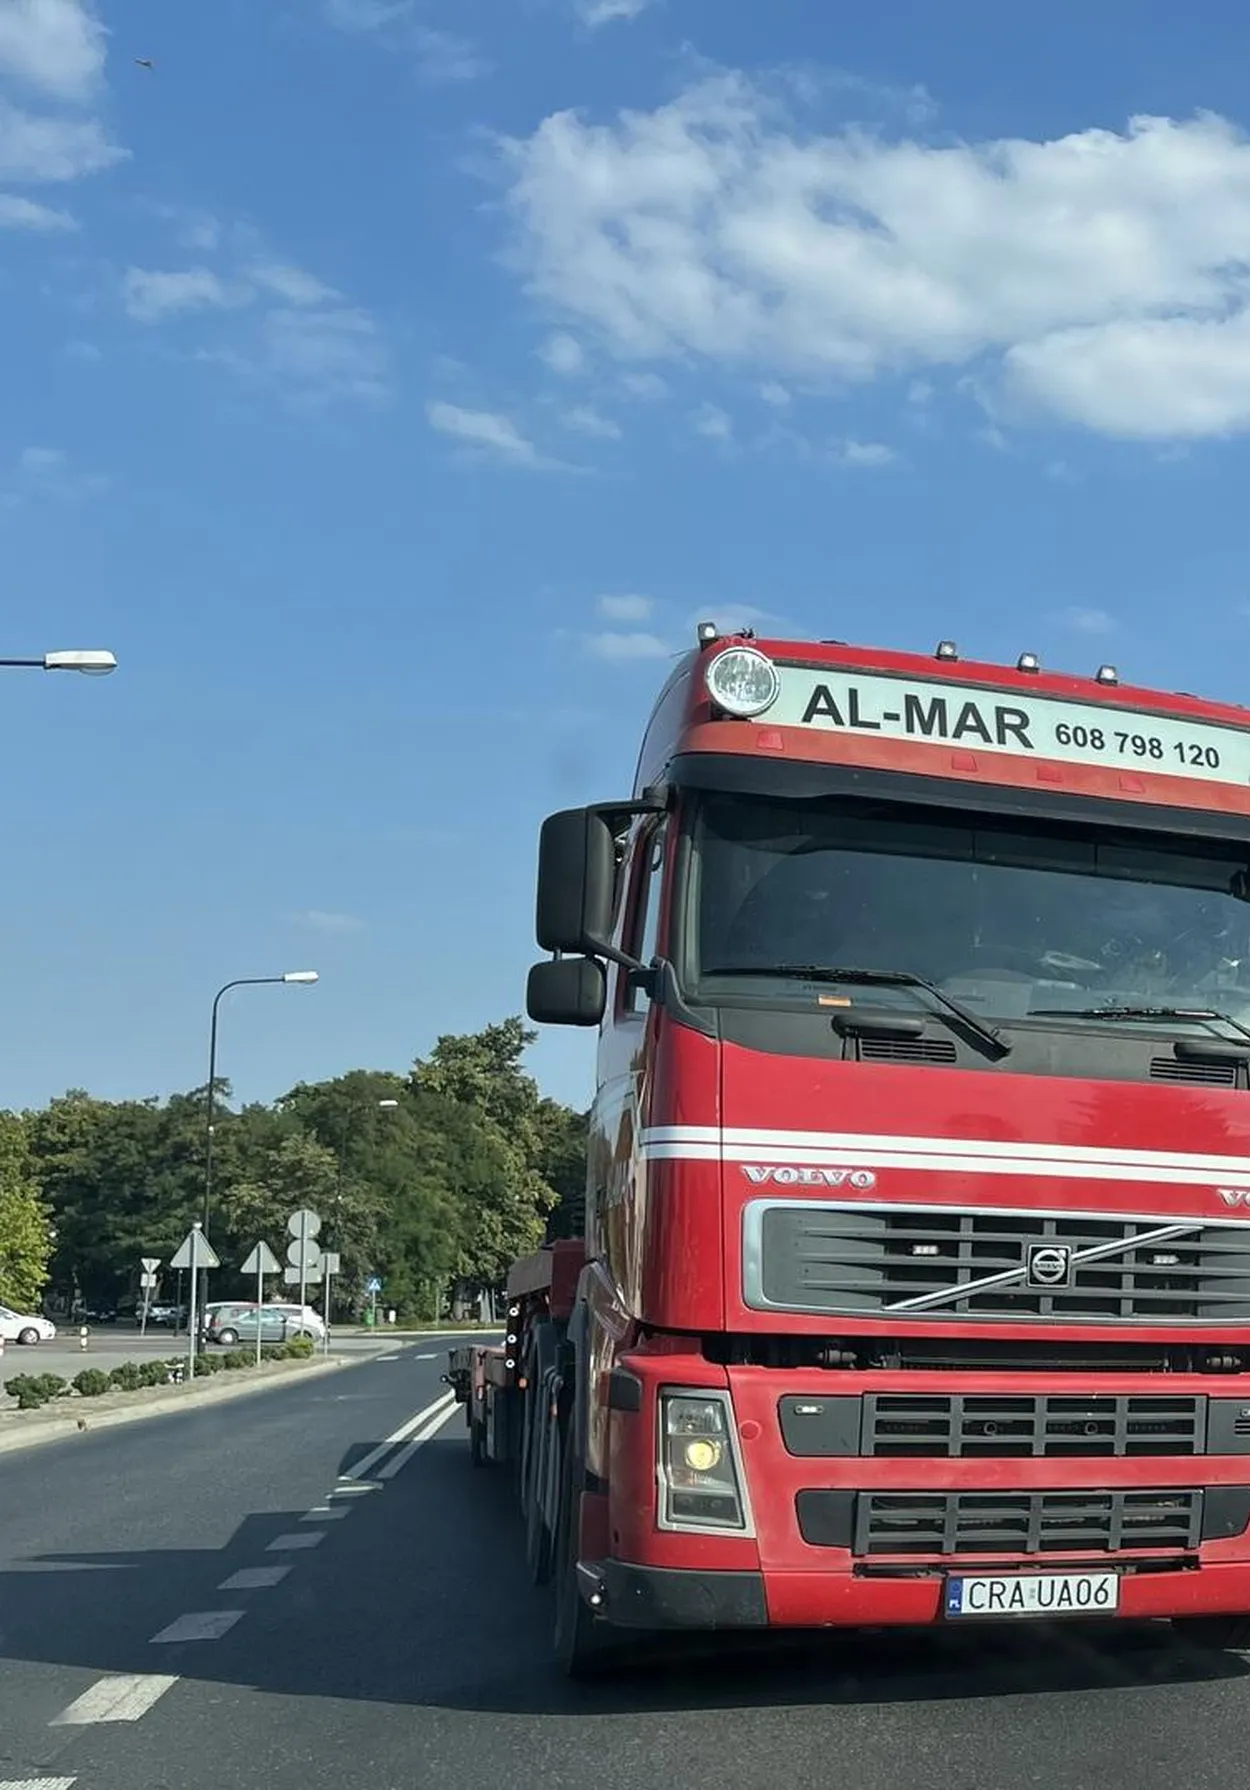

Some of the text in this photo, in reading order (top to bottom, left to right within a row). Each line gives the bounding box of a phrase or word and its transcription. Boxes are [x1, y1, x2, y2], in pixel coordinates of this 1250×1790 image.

[801, 684, 1220, 769] AL-MAR 608 798 120
[742, 1165, 876, 1188] VOLVO
[969, 1577, 1109, 1609] CRA UA06
